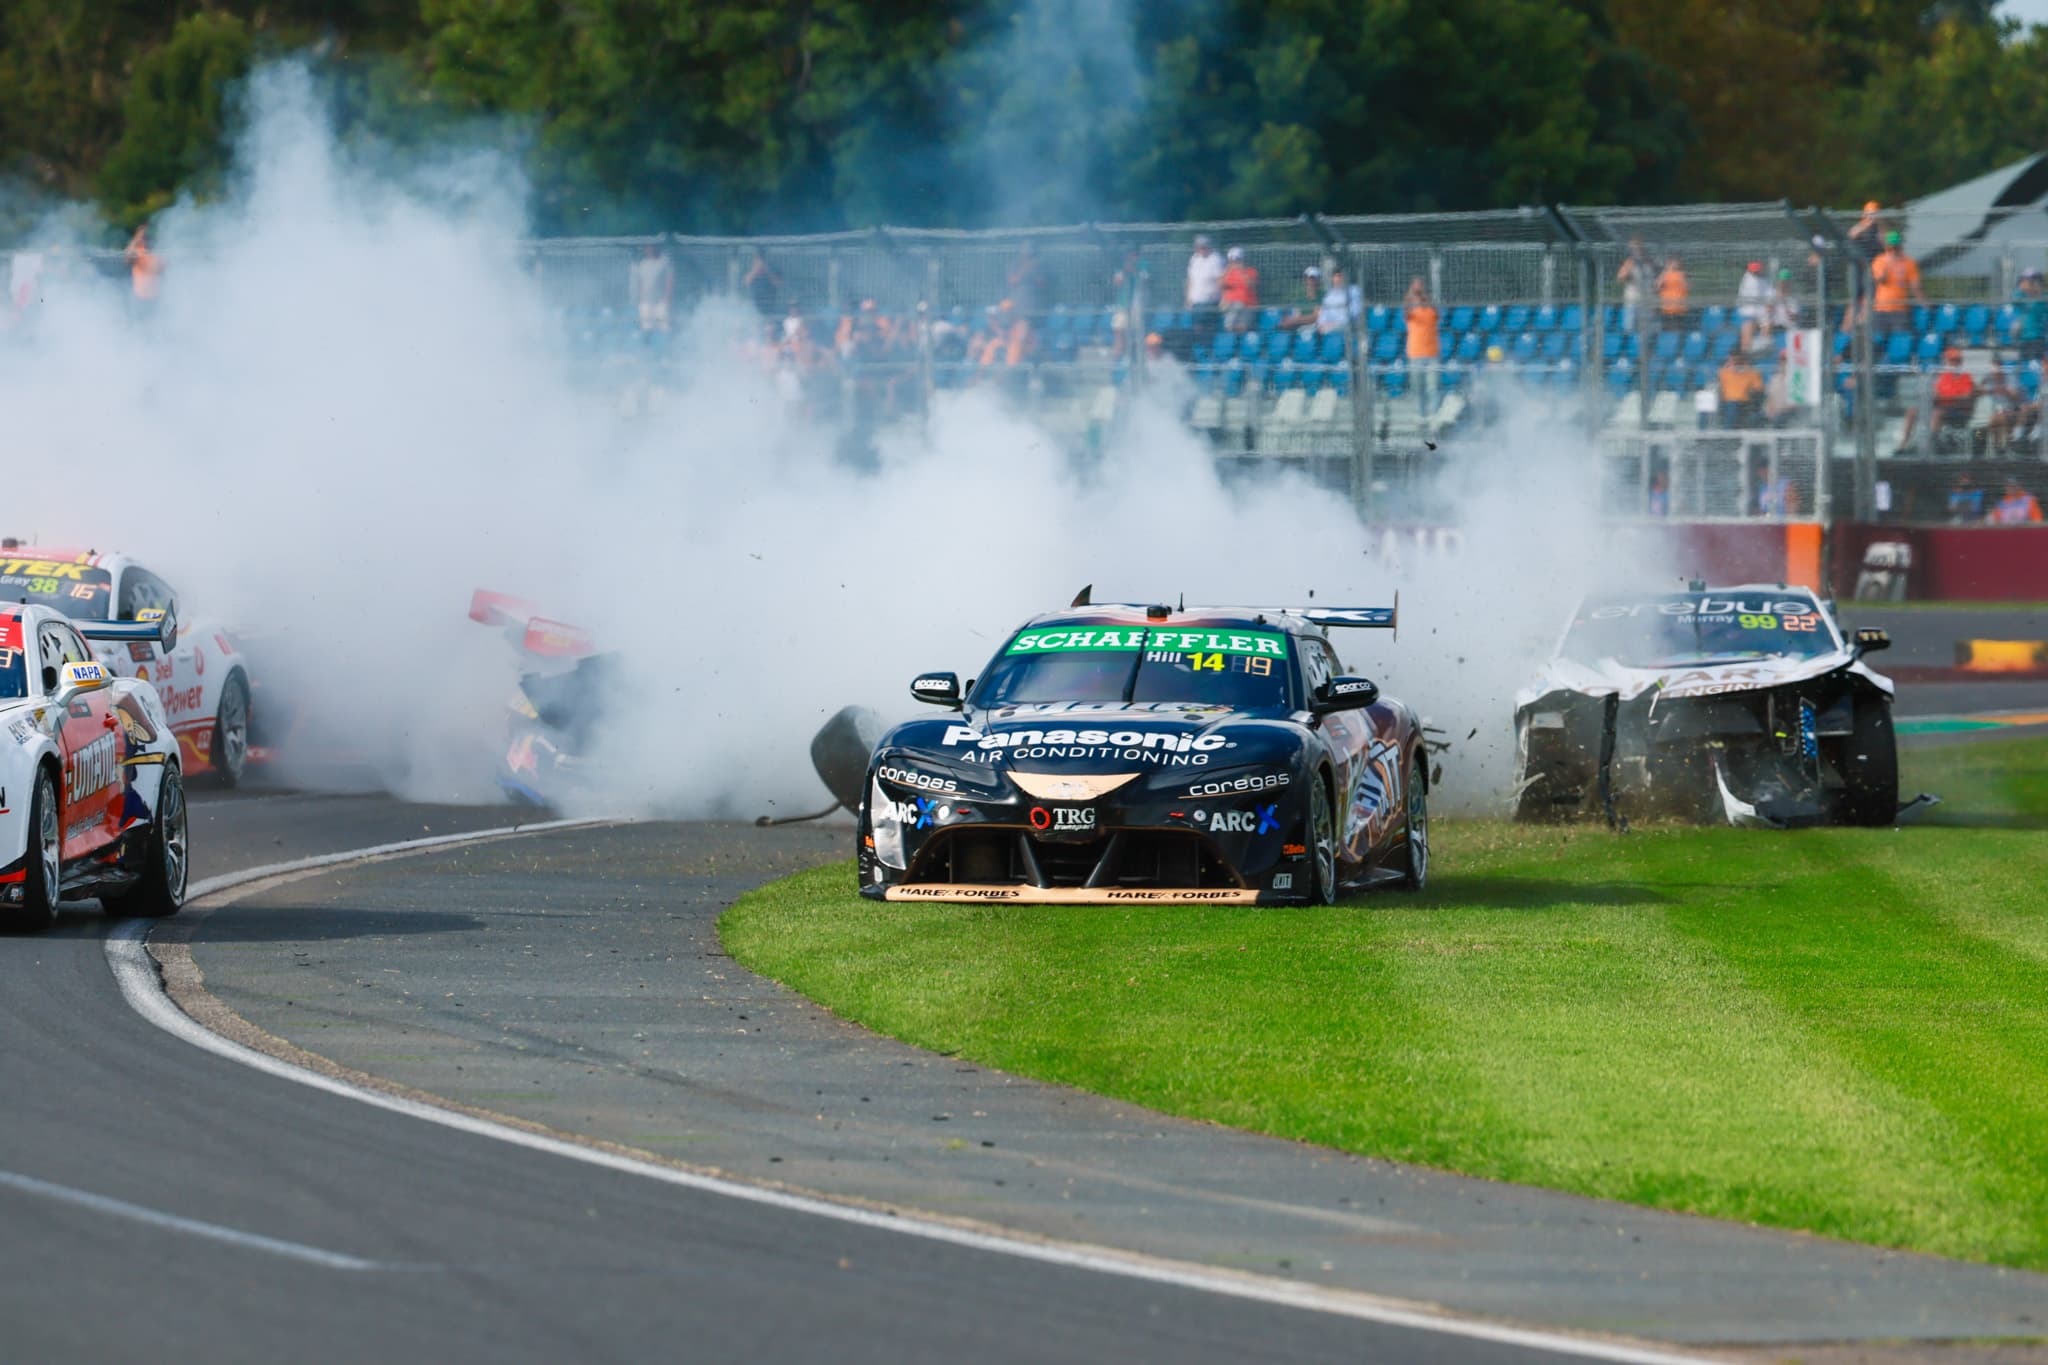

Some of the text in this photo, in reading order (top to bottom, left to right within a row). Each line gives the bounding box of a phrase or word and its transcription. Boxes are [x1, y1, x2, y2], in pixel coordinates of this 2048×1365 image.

[0, 559, 93, 580] TEK
[0, 575, 97, 600] Gray 38 16
[1592, 597, 1812, 618] erebus
[1738, 613, 1778, 630] 99
[1783, 614, 1817, 632] 22
[1012, 631, 1283, 655] SCHAEFFLER
[73, 666, 102, 679] NAPA
[1146, 651, 1273, 677] Hill 14 19
[942, 725, 1227, 752] Panasonic
[960, 747, 1209, 766] AIR CONDITIONING
[878, 765, 958, 793] coregas
[1189, 772, 1290, 797] coregas
[1053, 807, 1096, 826] TRG
[899, 887, 1020, 898] HARE FORBES
[1107, 890, 1241, 900] HARE FORBES
